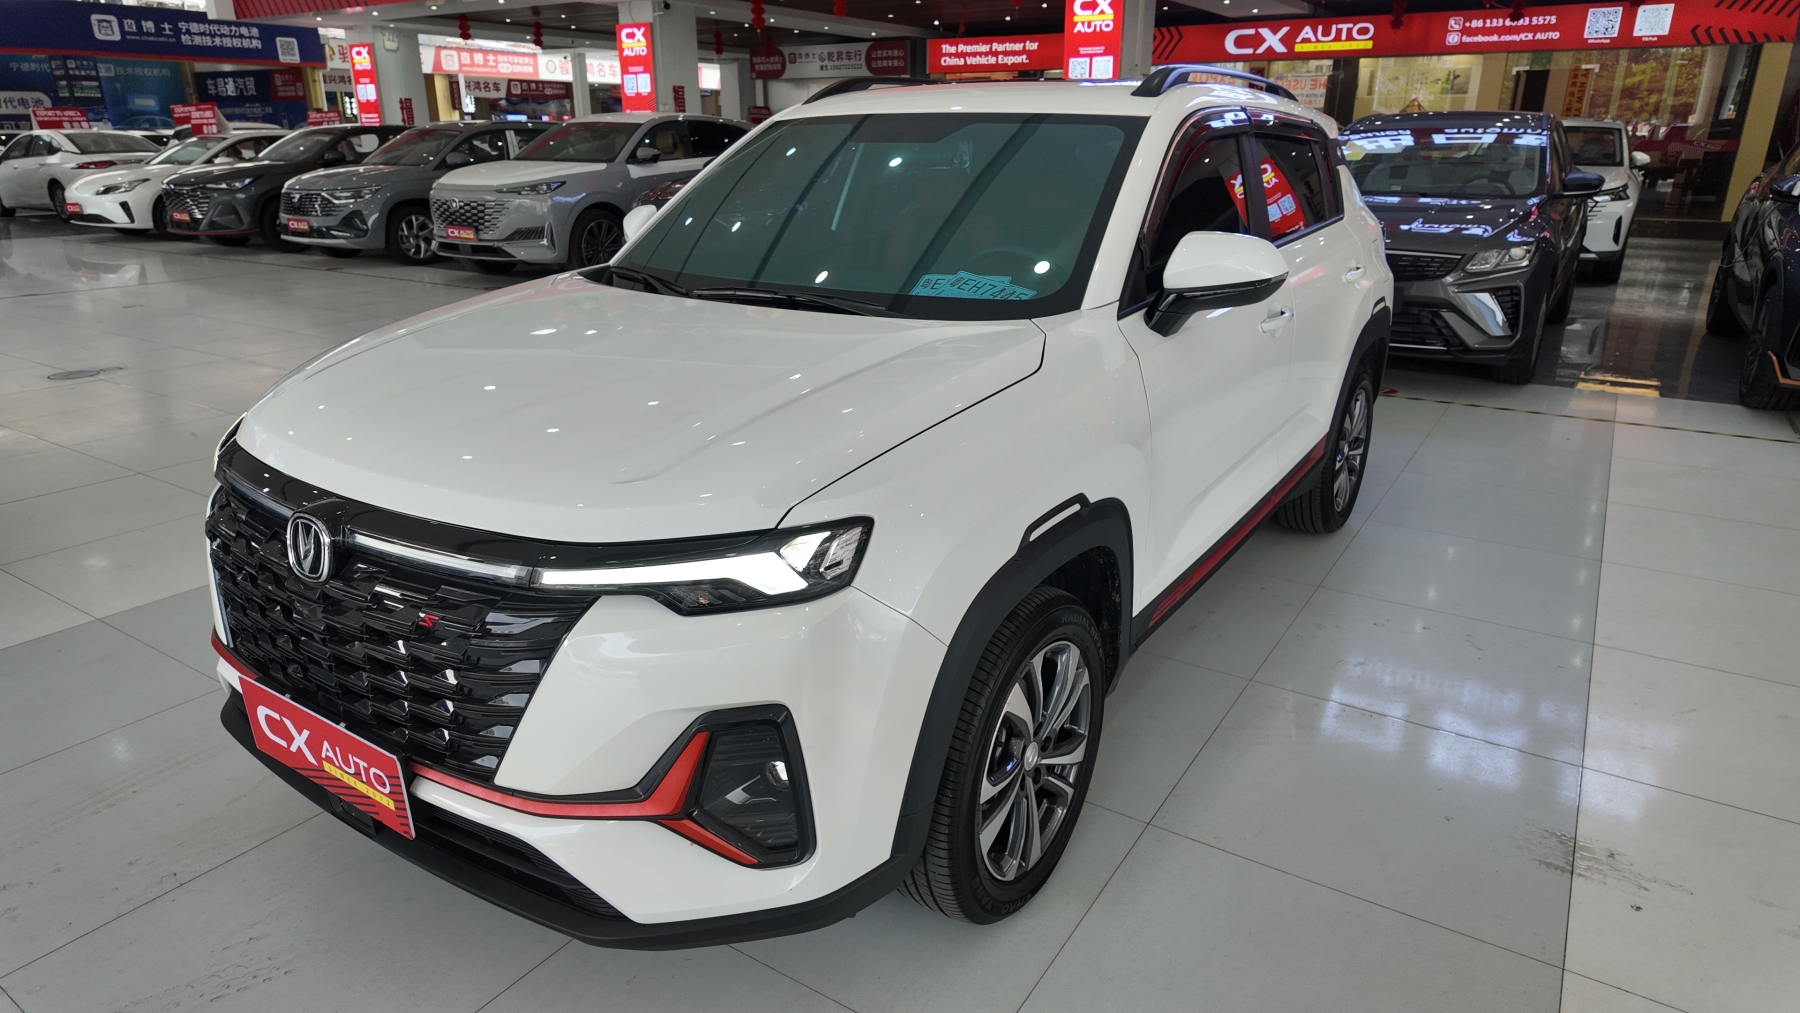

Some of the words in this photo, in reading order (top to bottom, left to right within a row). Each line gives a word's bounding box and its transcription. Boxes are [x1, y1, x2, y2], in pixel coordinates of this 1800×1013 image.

[1073, 0, 1114, 16] CX
[122, 18, 174, 35] 查博士
[177, 21, 259, 37] 宁德时代动力电池
[1073, 20, 1114, 33] AUTO
[1464, 19, 1483, 28] +86
[1485, 18, 1504, 27] 133
[1531, 15, 1557, 25] 5575
[181, 34, 262, 49] 检测技术授权机构
[621, 26, 647, 43] CX
[1224, 26, 1290, 54] CX
[1296, 23, 1374, 43] AUTO
[1462, 32, 1533, 43] facebook.com/CX
[1534, 31, 1560, 40] AUTO
[352, 46, 370, 59] CX
[622, 47, 648, 56] AUTO
[941, 43, 957, 54] The
[957, 42, 991, 53] Premier
[991, 41, 1023, 52] Partner
[1025, 40, 1039, 51] for
[354, 62, 371, 70] AUTO
[460, 52, 497, 66] 查博士
[941, 55, 964, 66] China
[965, 54, 996, 65] Vehicle
[997, 53, 1030, 65] Export.
[447, 228, 460, 237] CX
[1061, 613, 1091, 630] RADIAL
[256, 705, 318, 766] CX
[321, 740, 391, 794] AUTO
[327, 764, 358, 788] SINCE
[364, 786, 392, 807] 2012
[971, 876, 995, 910] YANG
[1001, 893, 1031, 913] CHAO
